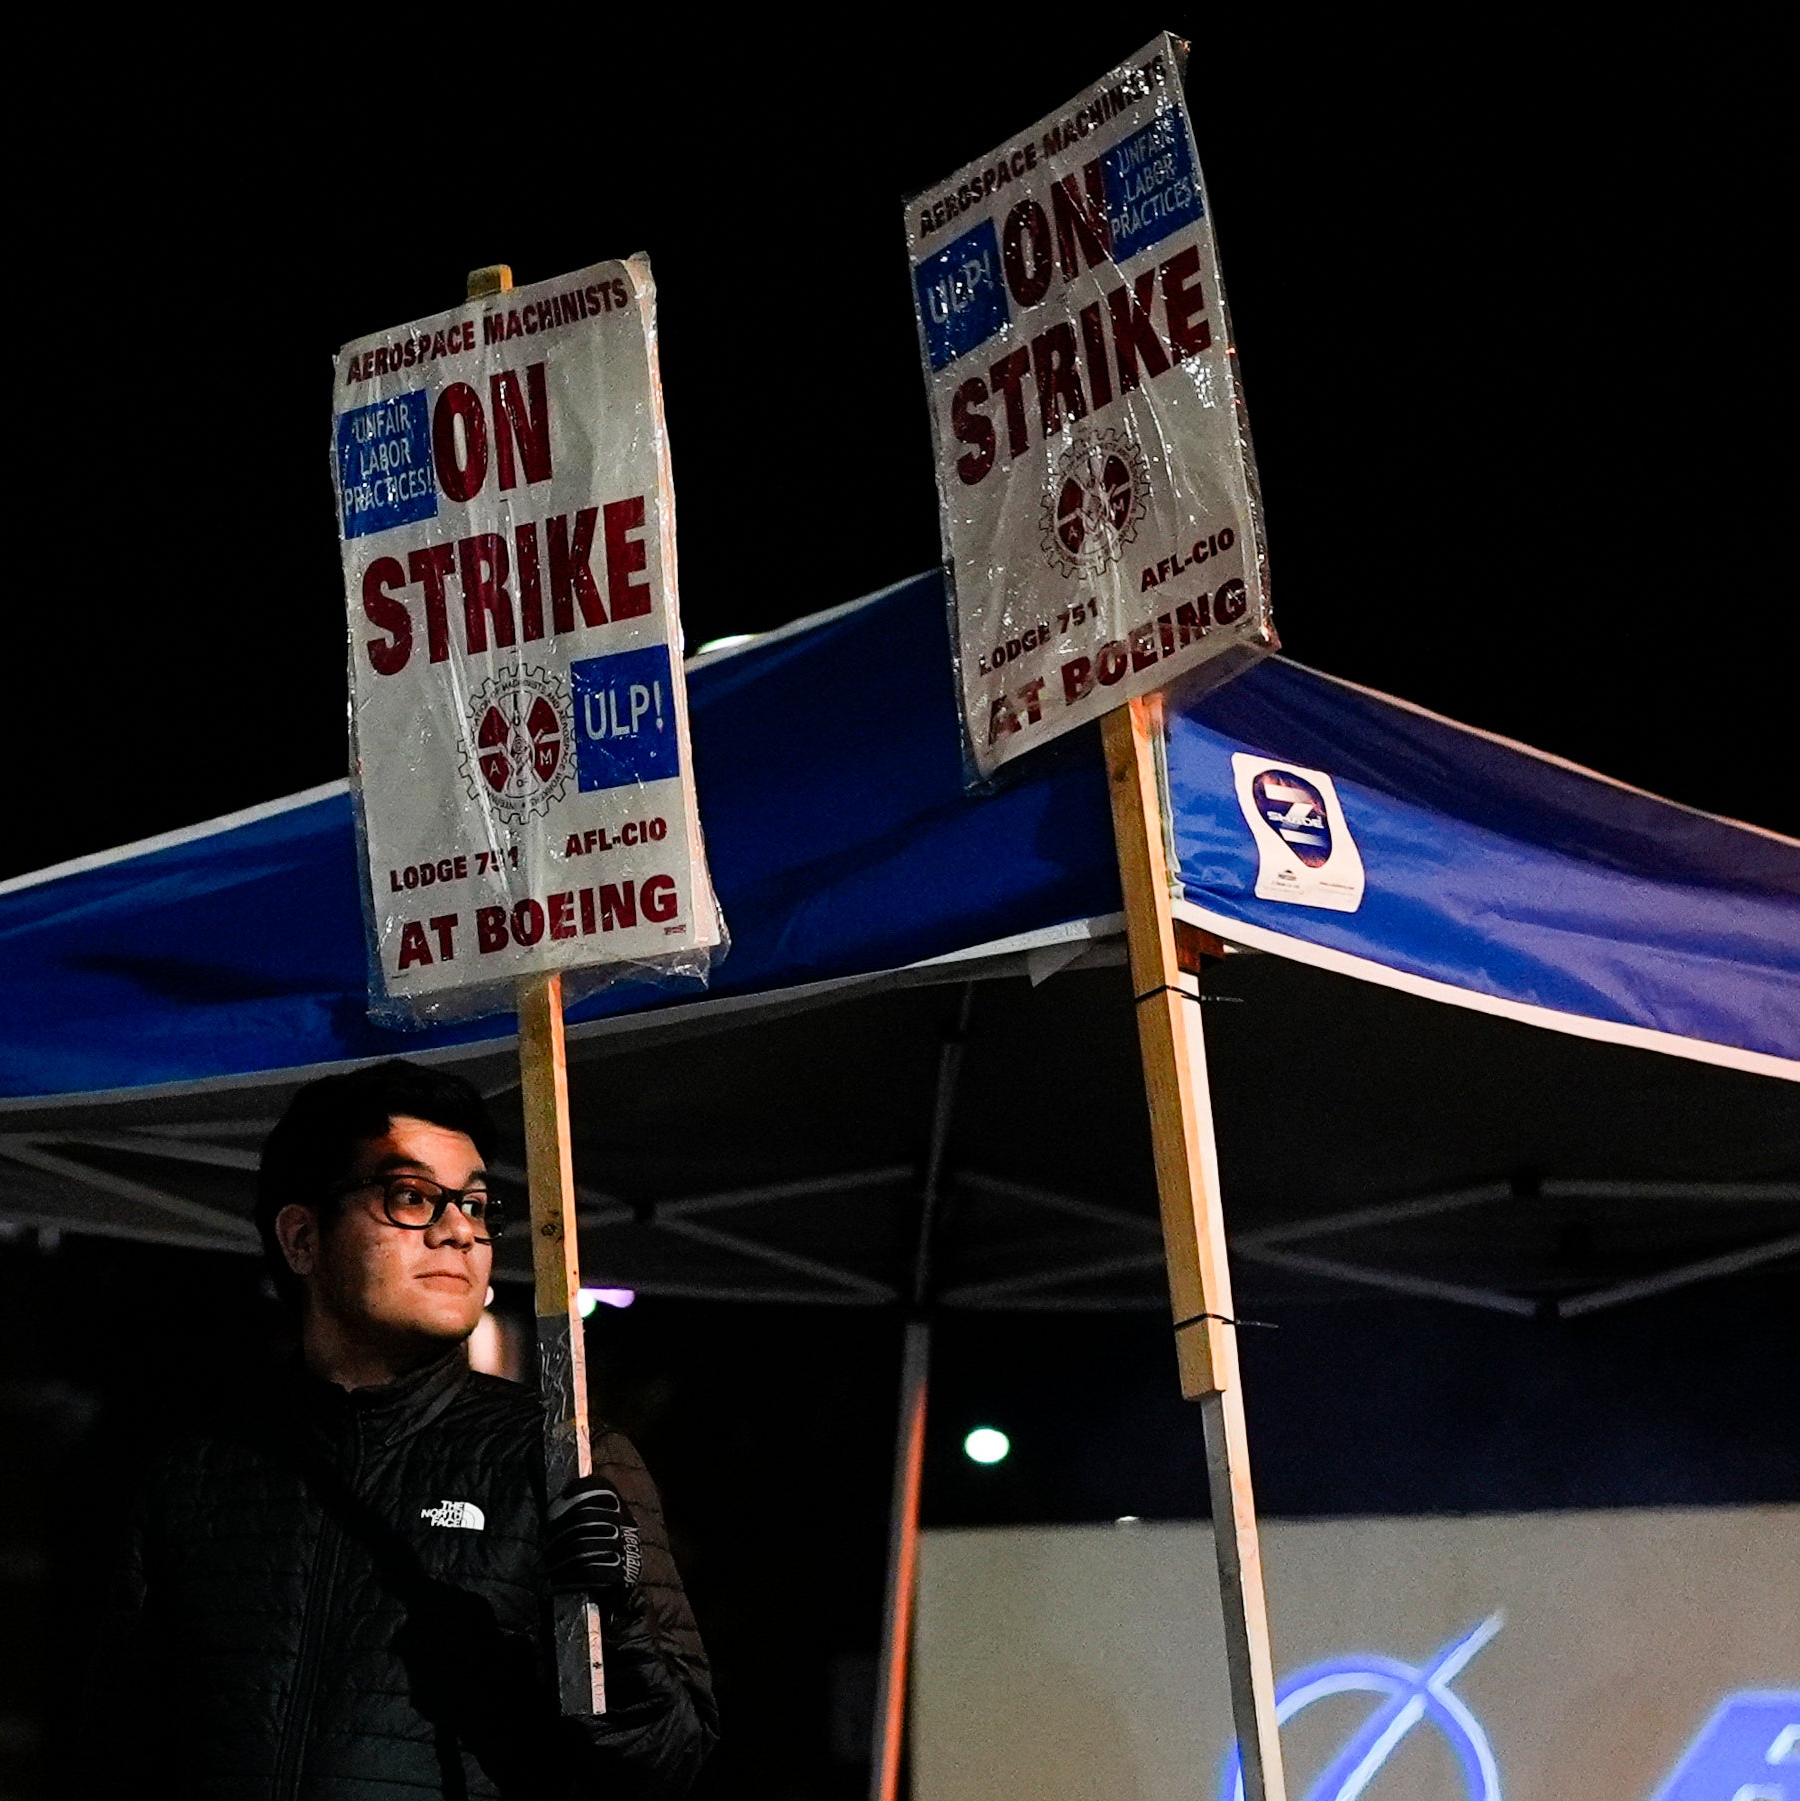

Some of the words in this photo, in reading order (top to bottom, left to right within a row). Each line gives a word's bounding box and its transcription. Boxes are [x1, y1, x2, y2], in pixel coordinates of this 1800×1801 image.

[920, 143, 1037, 238] AEROSPACE
[1042, 55, 1167, 159] MACHINISTS
[1126, 155, 1176, 201] LABOR
[1003, 156, 1107, 307] ON
[1111, 177, 1193, 241] PRACTICES
[927, 249, 994, 325] ULP!
[347, 321, 475, 385] AEROSPACE
[483, 277, 628, 346] MACHINISTS
[952, 245, 1212, 485] STRIKE
[354, 403, 411, 444] UNFAIR
[432, 361, 552, 503] ON
[344, 464, 437, 515] PRACTICES!
[359, 437, 411, 478] LABOR
[362, 495, 651, 676] STRIKE
[1141, 527, 1235, 592] AFL-CIO
[979, 621, 1051, 676] LODGE
[1057, 597, 1097, 633] 751
[989, 676, 1045, 745] AT
[1061, 577, 1249, 706] BOEING
[584, 680, 665, 740] ULP!
[390, 856, 467, 892] LODGE
[475, 846, 518, 875] 751
[566, 816, 668, 858] AFL-CIO
[399, 913, 458, 970] AT
[476, 874, 679, 954] BOEING
[421, 1508, 463, 1519] NORTH
[440, 1500, 464, 1510] THE
